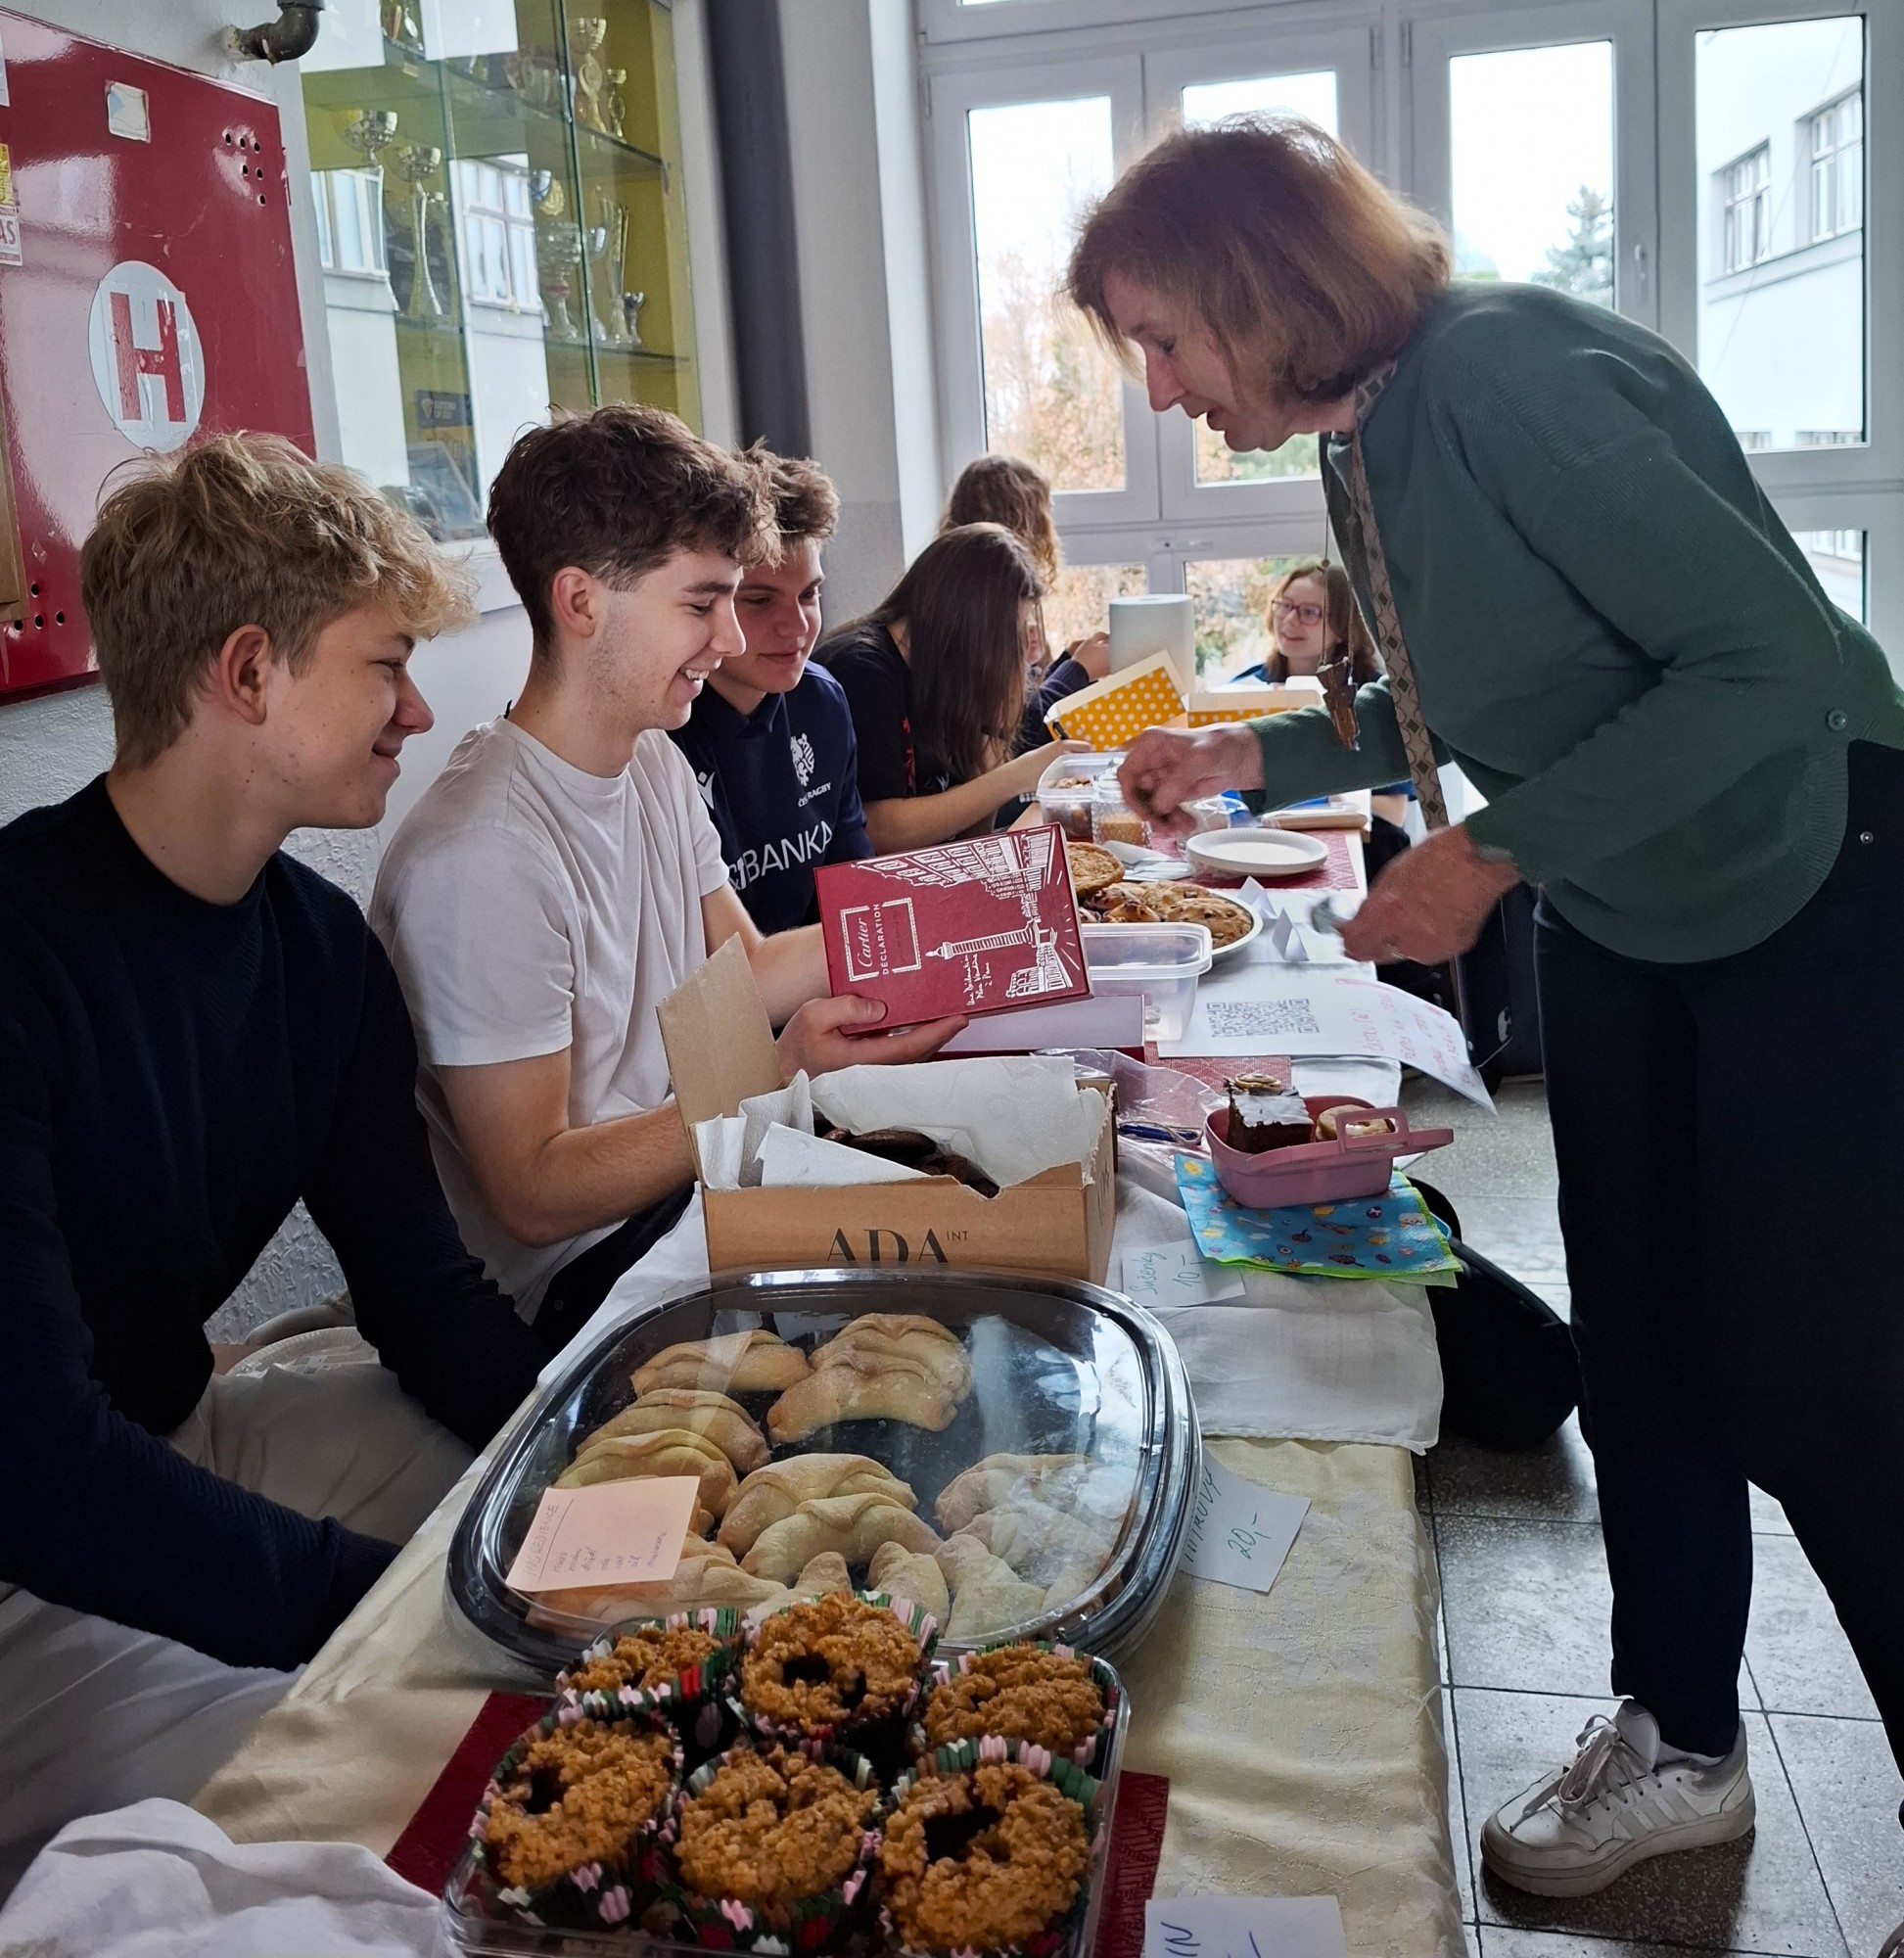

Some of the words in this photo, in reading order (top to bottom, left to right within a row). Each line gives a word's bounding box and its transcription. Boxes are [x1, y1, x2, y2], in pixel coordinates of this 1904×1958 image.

[110, 292, 187, 423] H
[858, 917, 873, 967] Cartier
[827, 1228, 949, 1263] ADA
[947, 1231, 969, 1241] INT
[1129, 1252, 1167, 1294] Sušenky
